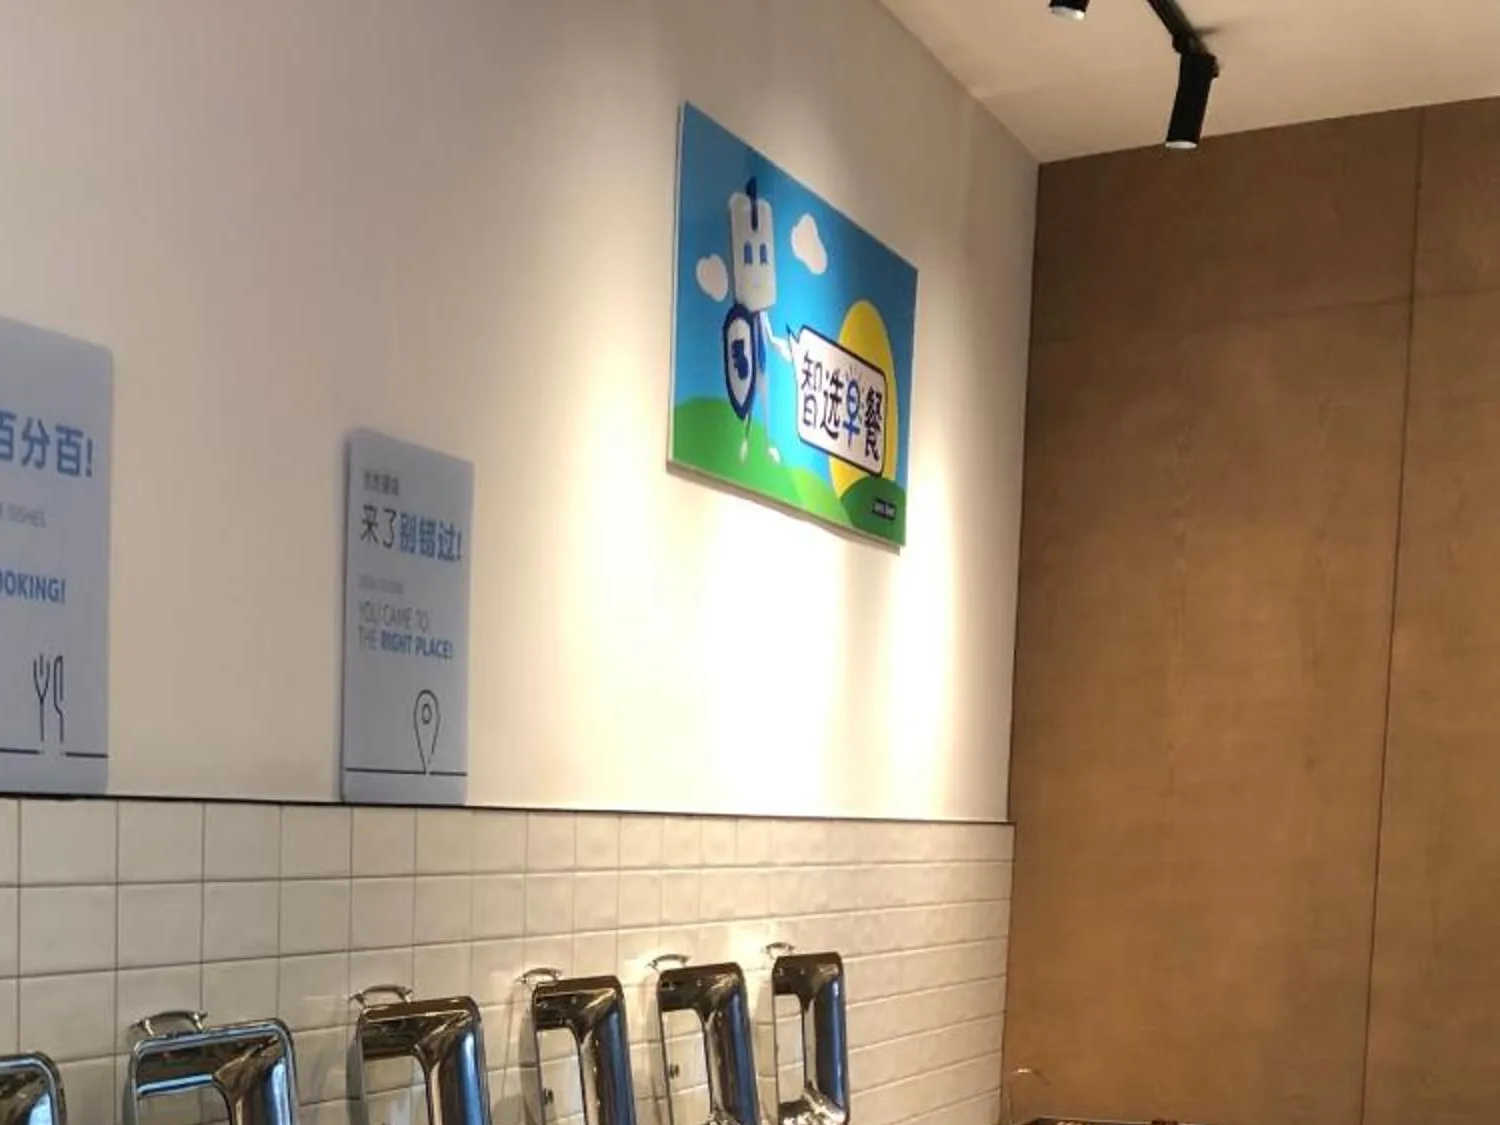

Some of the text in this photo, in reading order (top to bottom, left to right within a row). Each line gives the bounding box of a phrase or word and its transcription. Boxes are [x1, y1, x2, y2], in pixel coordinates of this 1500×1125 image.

[800, 351, 883, 461] 智选早餐
[360, 504, 462, 561] 来了别错过!
[380, 629, 412, 656] RIGHT
